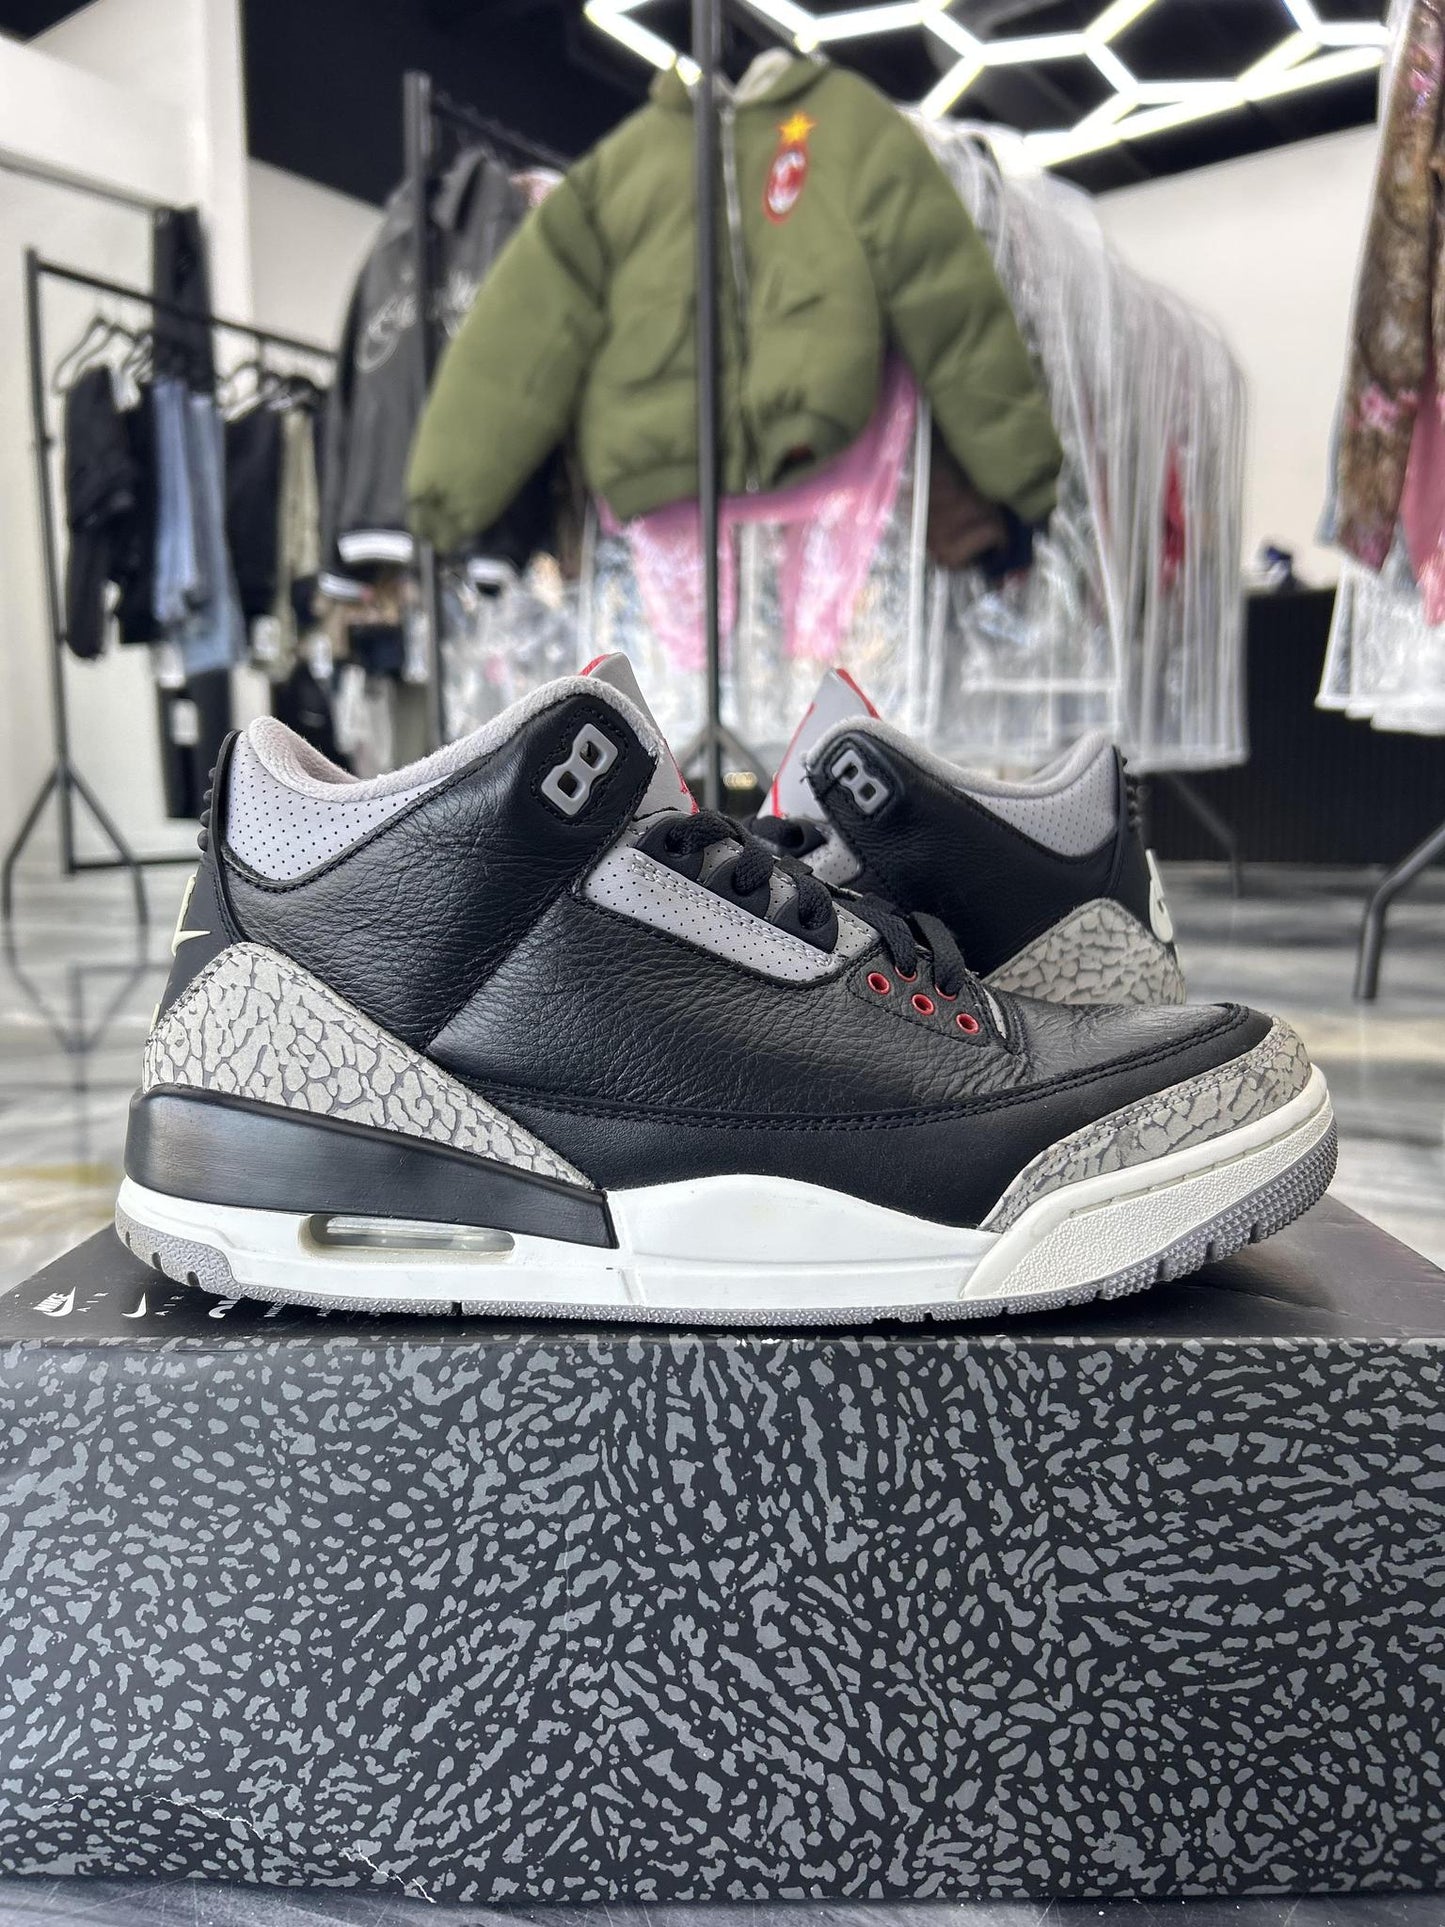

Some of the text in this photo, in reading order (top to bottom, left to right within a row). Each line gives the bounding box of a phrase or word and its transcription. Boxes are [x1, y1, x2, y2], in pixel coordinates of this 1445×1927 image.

[33, 1292, 70, 1313] NIKE
[77, 1292, 109, 1312] AIR
[154, 1296, 185, 1316] AIR
